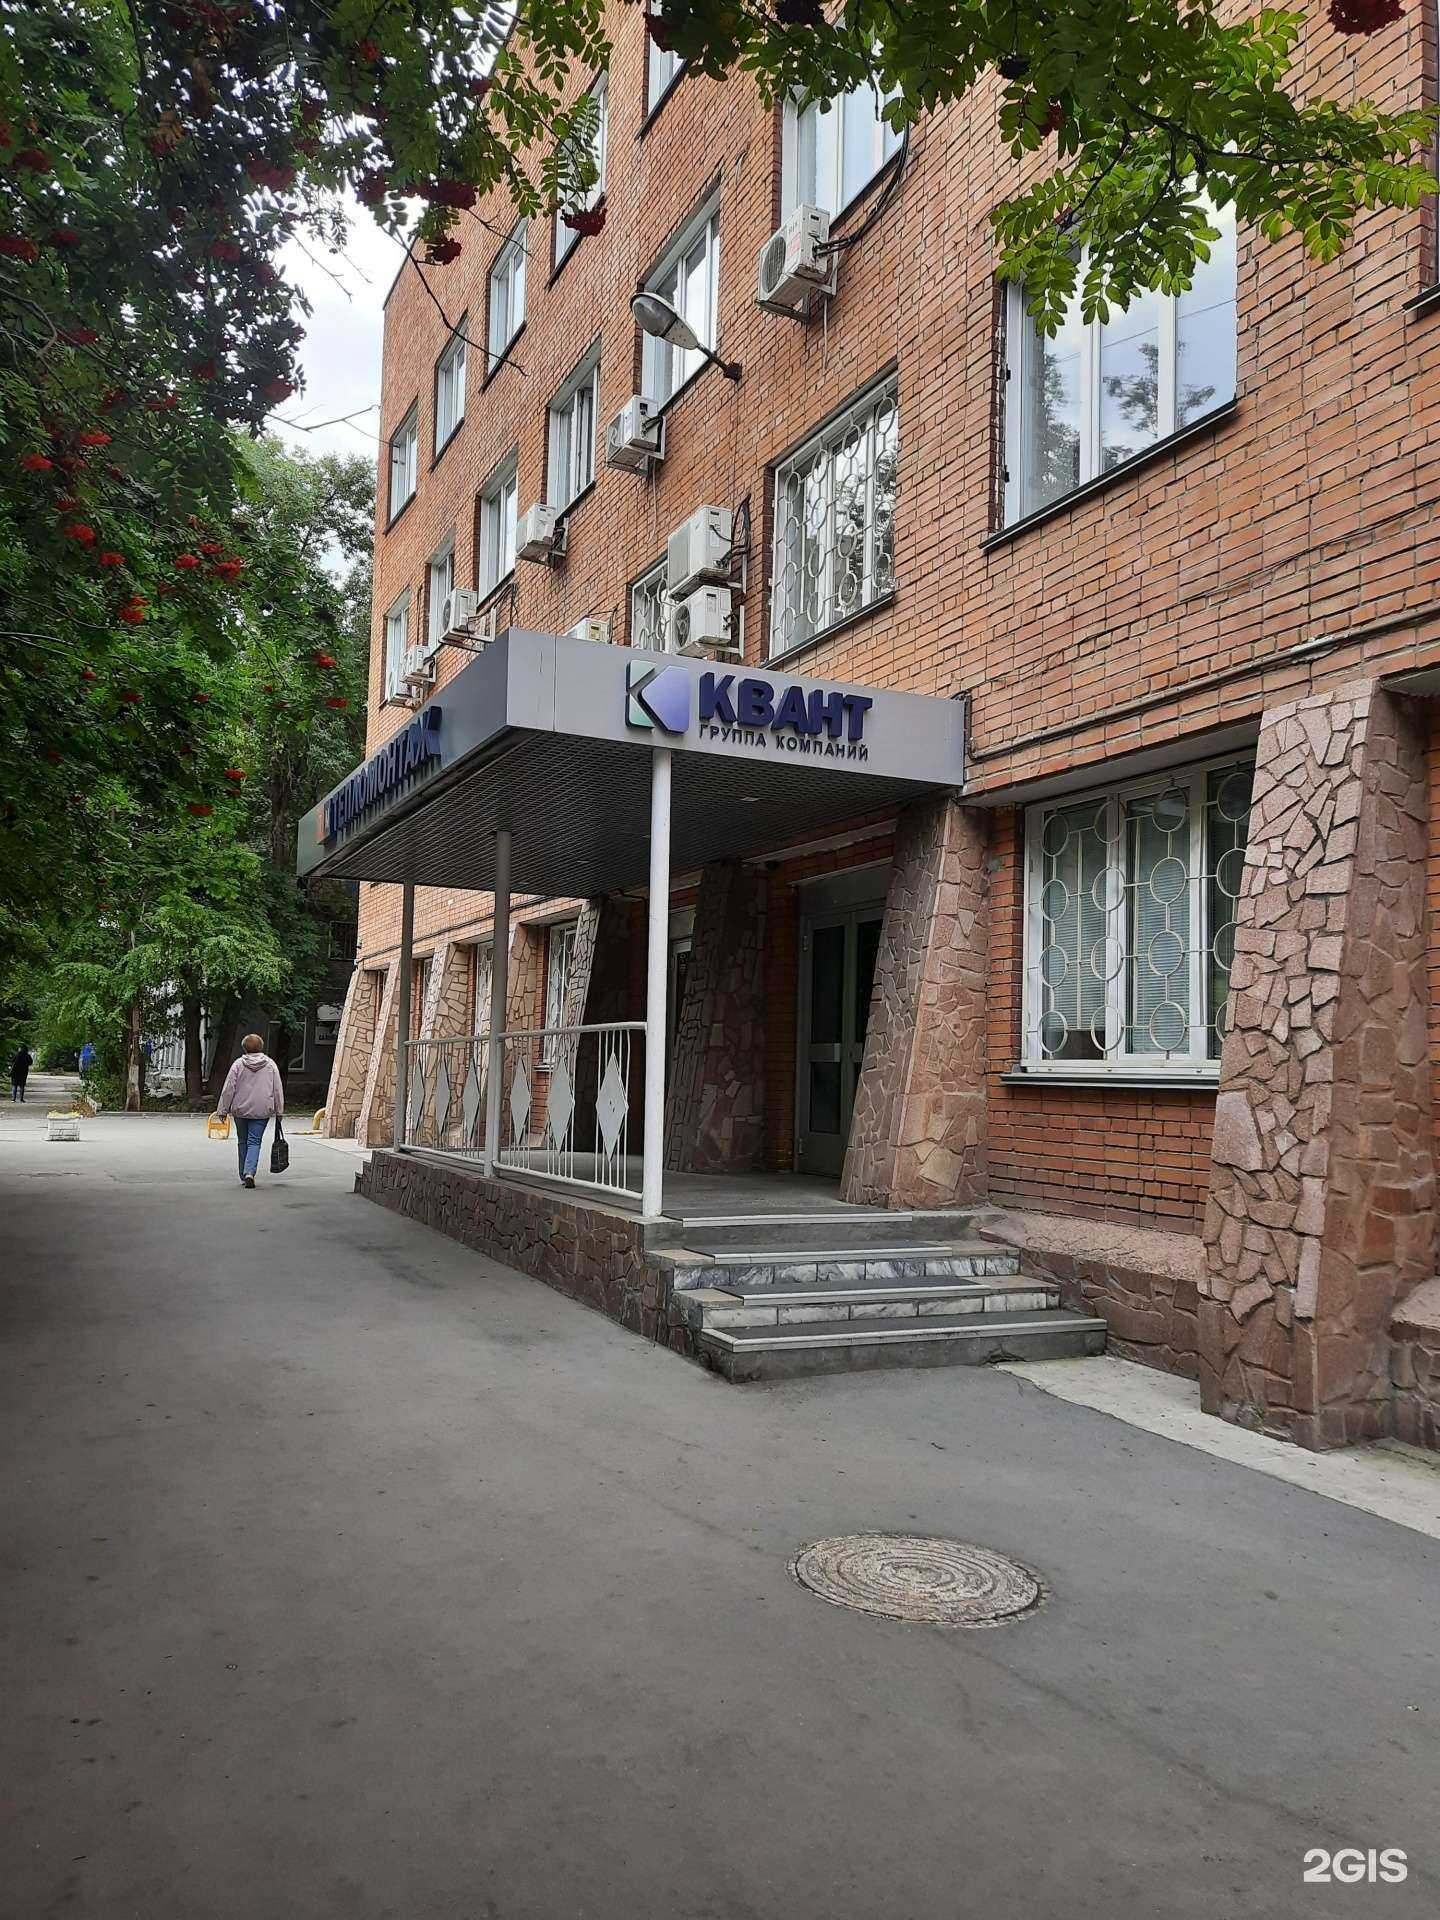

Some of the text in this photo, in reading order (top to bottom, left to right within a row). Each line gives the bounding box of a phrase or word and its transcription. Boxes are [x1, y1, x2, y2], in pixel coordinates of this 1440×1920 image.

[699, 672, 873, 741] КВАНТ
[700, 723, 869, 762] ГРУППА КОМПАНИЙ
